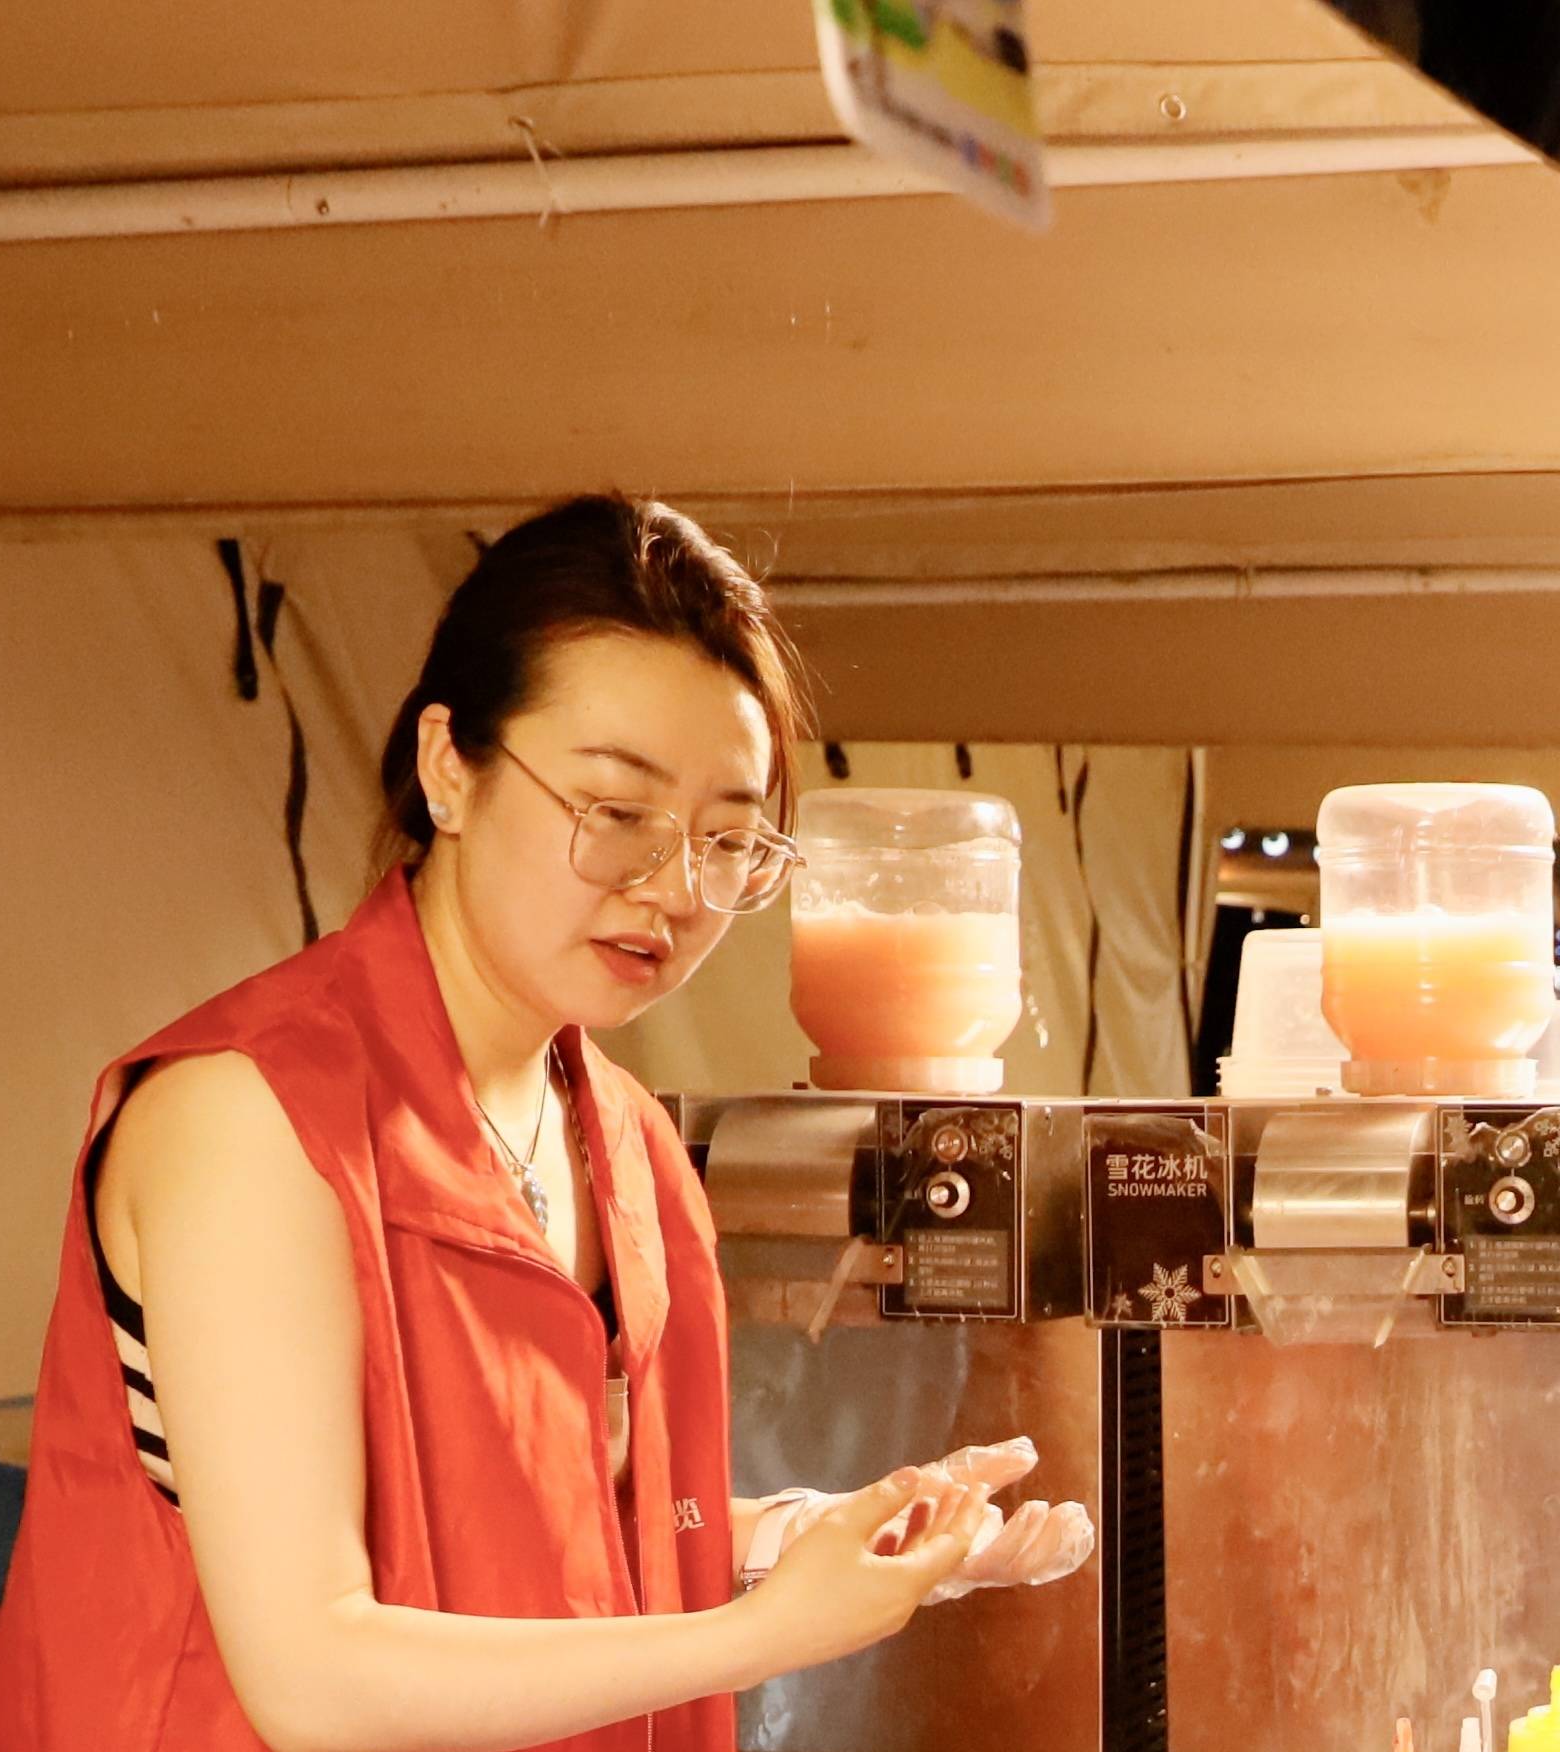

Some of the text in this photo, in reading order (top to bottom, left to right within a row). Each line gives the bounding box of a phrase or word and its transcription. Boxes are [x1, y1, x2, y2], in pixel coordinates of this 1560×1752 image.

[1105, 1153, 1208, 1180] 雪花冰机
[1107, 1182, 1208, 1197] SNOWMAKER
